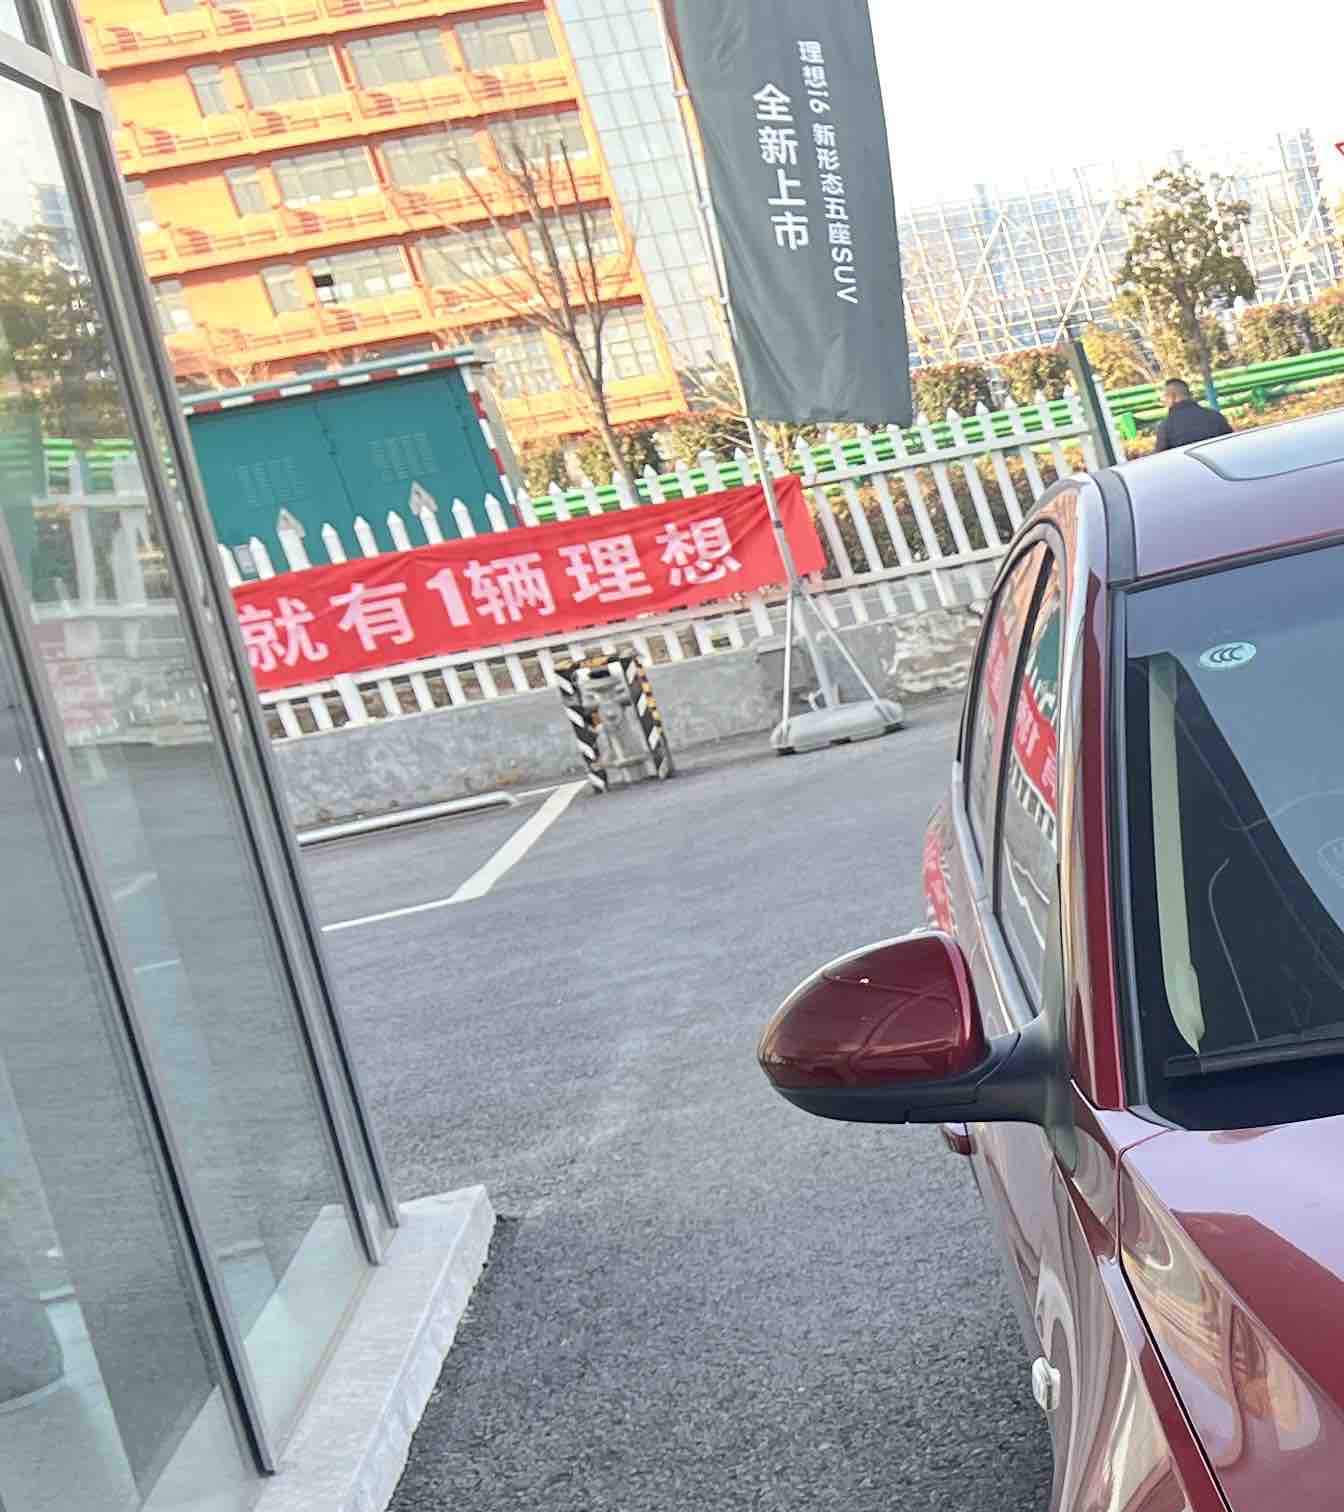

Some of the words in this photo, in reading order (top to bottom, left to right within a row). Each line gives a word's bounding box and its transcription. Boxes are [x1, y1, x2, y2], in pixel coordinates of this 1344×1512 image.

[752, 83, 809, 250] 全新上市
[237, 517, 742, 672] 就有1辆理想
